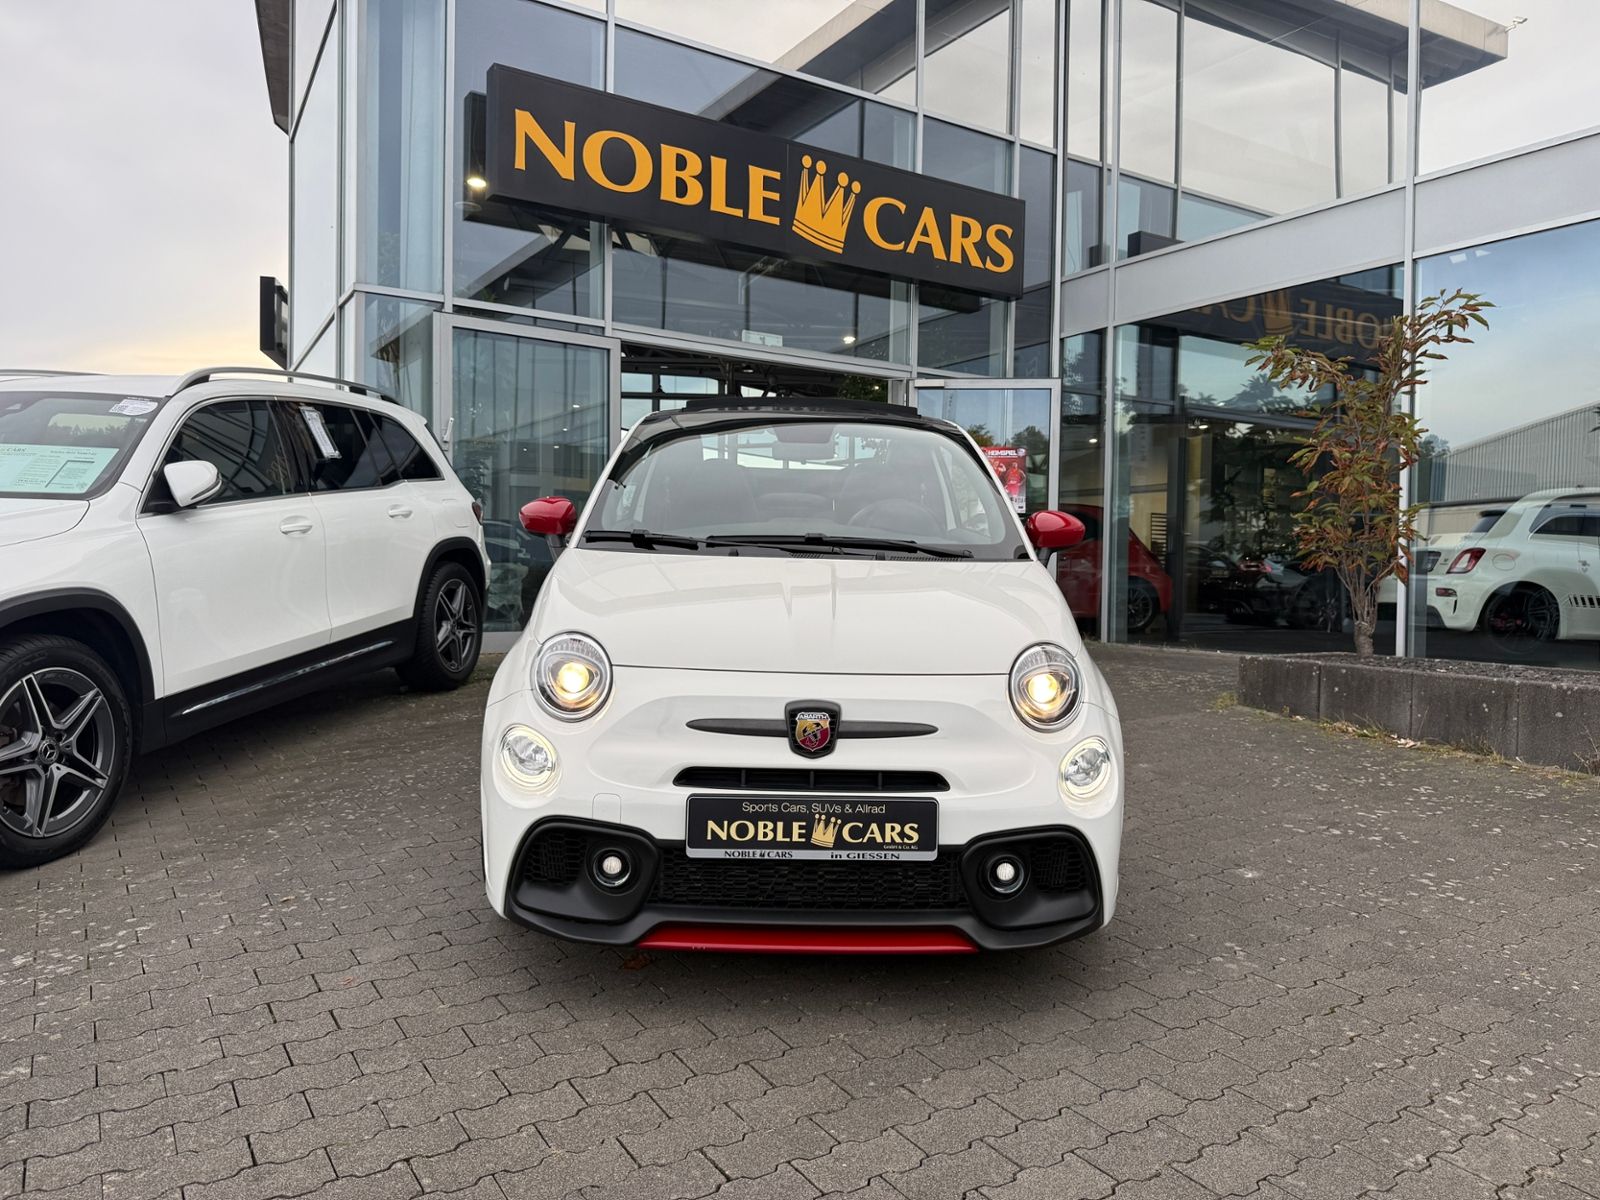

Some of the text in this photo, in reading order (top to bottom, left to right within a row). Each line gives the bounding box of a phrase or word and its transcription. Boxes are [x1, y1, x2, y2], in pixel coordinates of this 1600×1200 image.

[514, 109, 1015, 274] NOBLE CARS
[742, 802, 886, 814] Sports Cars, SUVs & Allrad
[706, 820, 919, 844] NOBLE CARS
[724, 850, 900, 860] NOBLE CARS in GIESSEN
